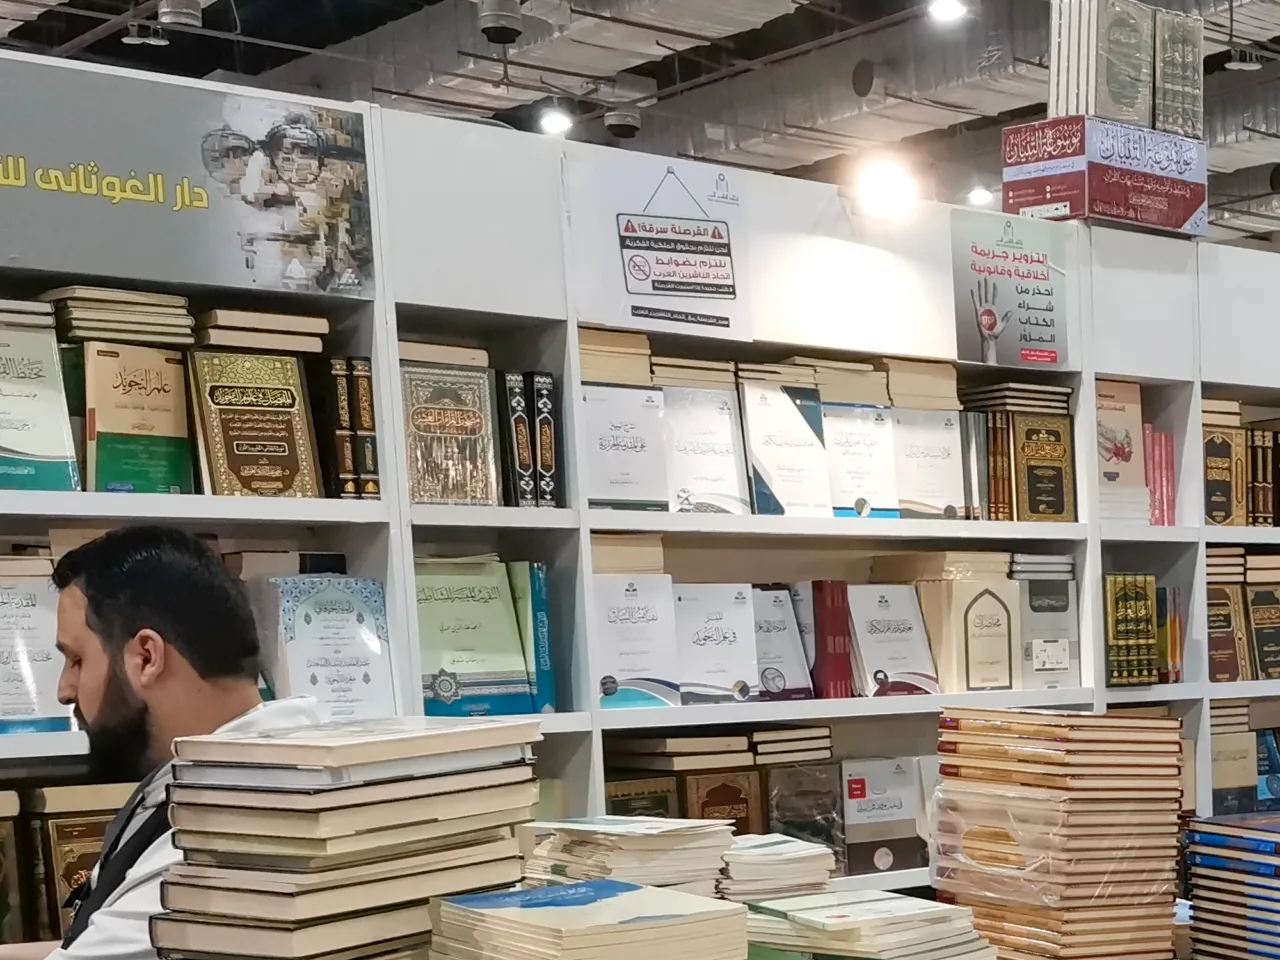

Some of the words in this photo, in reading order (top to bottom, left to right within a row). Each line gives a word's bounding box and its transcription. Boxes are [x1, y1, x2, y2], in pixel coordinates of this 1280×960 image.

[173, 177, 209, 212] دار
[671, 226, 709, 237] القرصنة
[971, 242, 1009, 259] جريمة
[655, 255, 697, 267] بضوابط
[699, 257, 727, 268] نلتزم
[1012, 253, 1048, 264] التزوير
[653, 269, 677, 278] العرب
[678, 270, 711, 280] الناشرين
[1015, 283, 1030, 296] من
[1032, 286, 1054, 297] احذر
[1018, 301, 1054, 312] شراء
[1018, 316, 1055, 328] الكتاب
